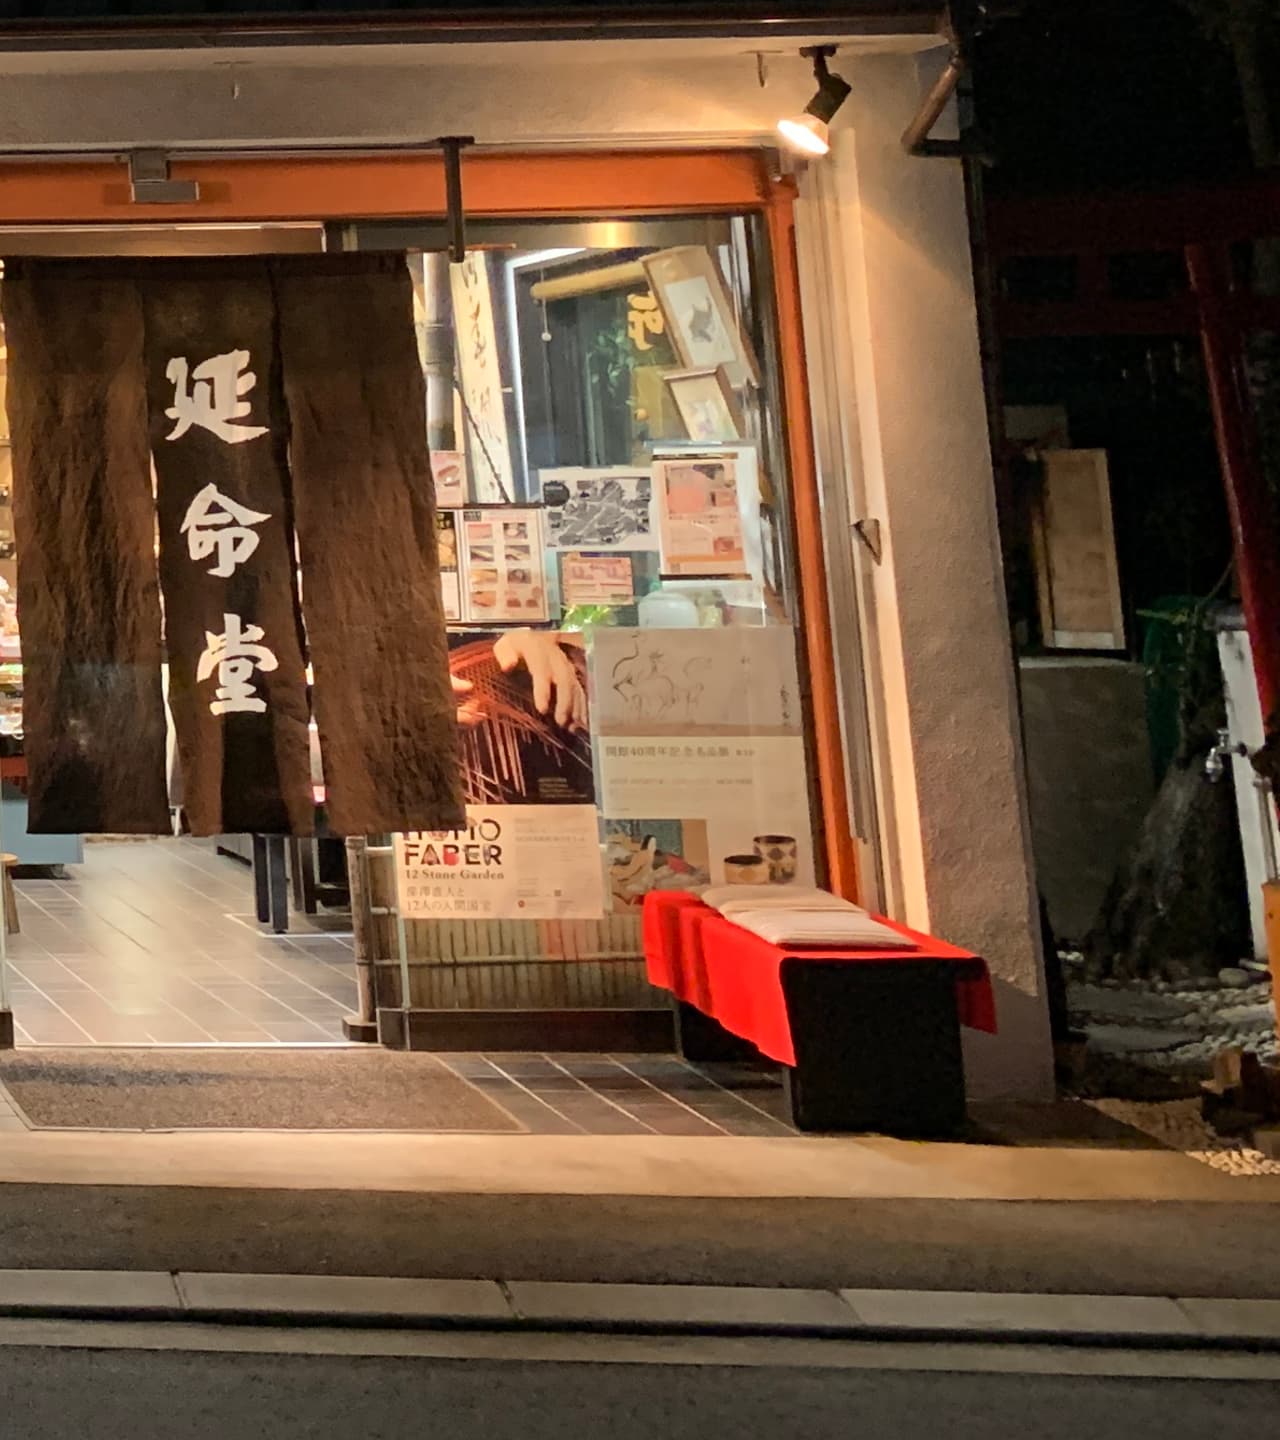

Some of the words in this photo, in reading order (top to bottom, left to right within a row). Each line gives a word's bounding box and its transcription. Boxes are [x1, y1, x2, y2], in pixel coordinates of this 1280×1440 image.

[165, 349, 278, 716] 延命堂
[404, 843, 503, 866] FABER
[405, 869, 419, 881] 12
[422, 869, 456, 881] Stone
[460, 868, 505, 881] Garden
